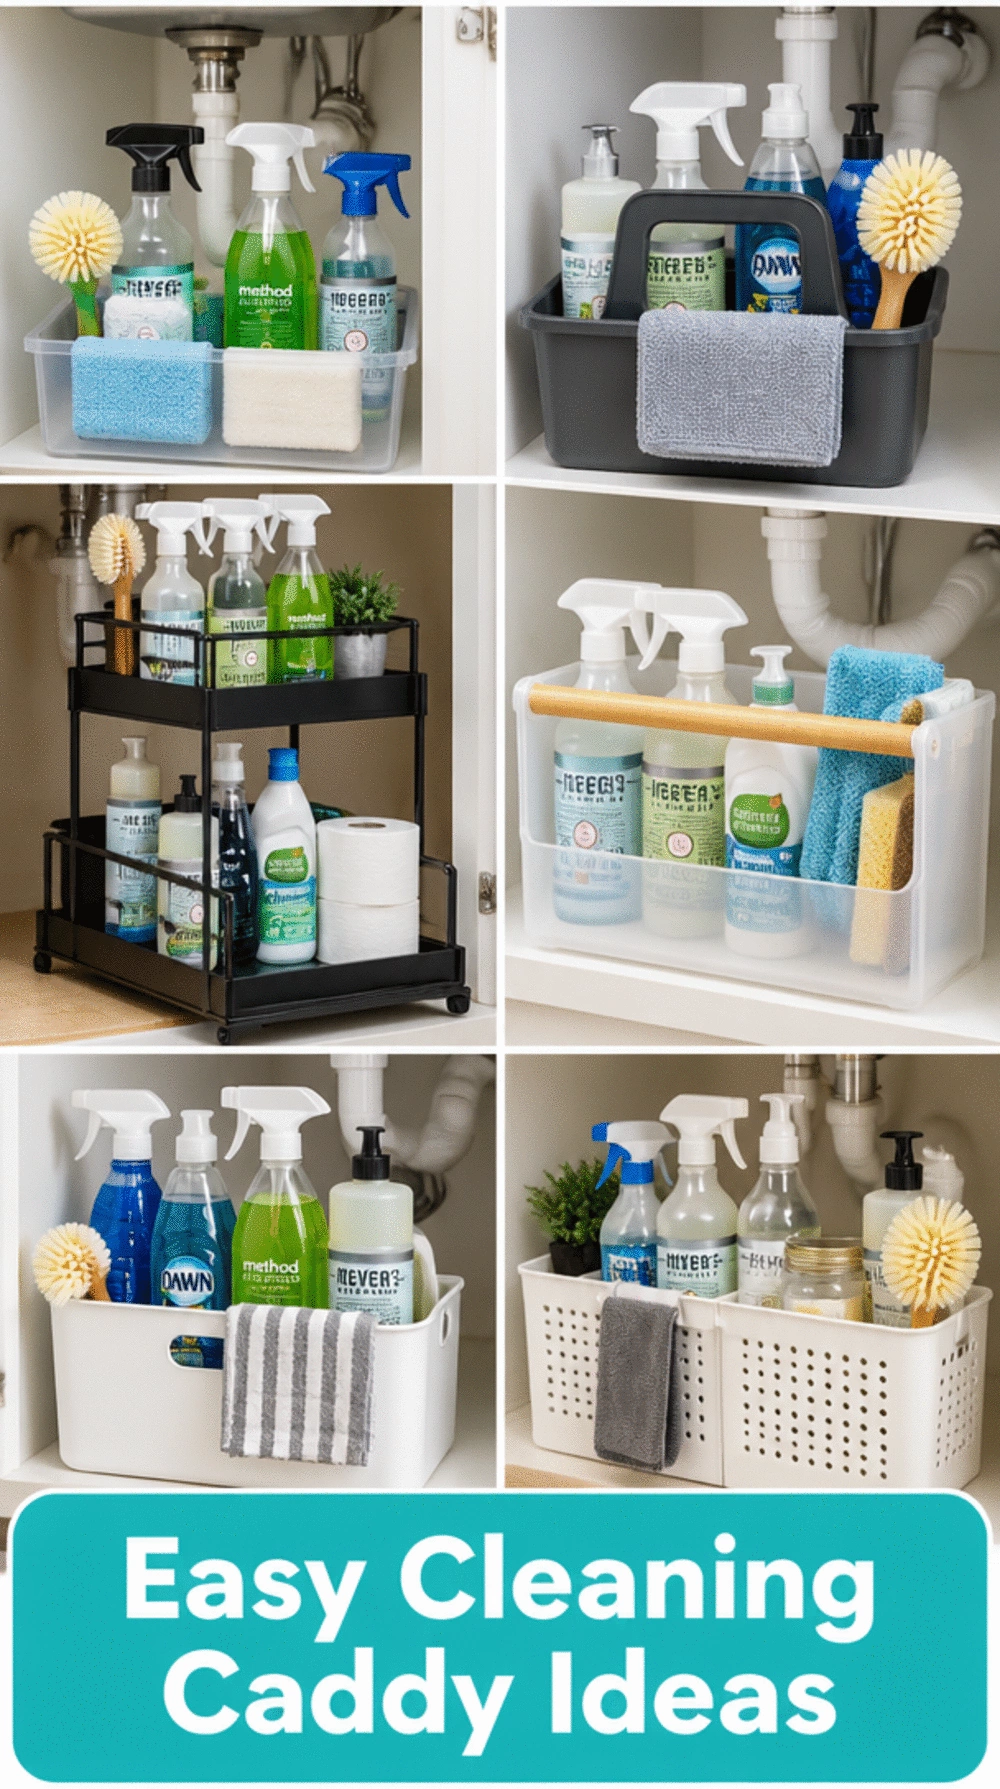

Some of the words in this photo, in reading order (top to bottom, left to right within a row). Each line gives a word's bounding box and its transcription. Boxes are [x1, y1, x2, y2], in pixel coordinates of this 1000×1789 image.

[239, 284, 293, 298] method
[243, 1259, 300, 1275] method
[162, 1270, 214, 1293] DAWN
